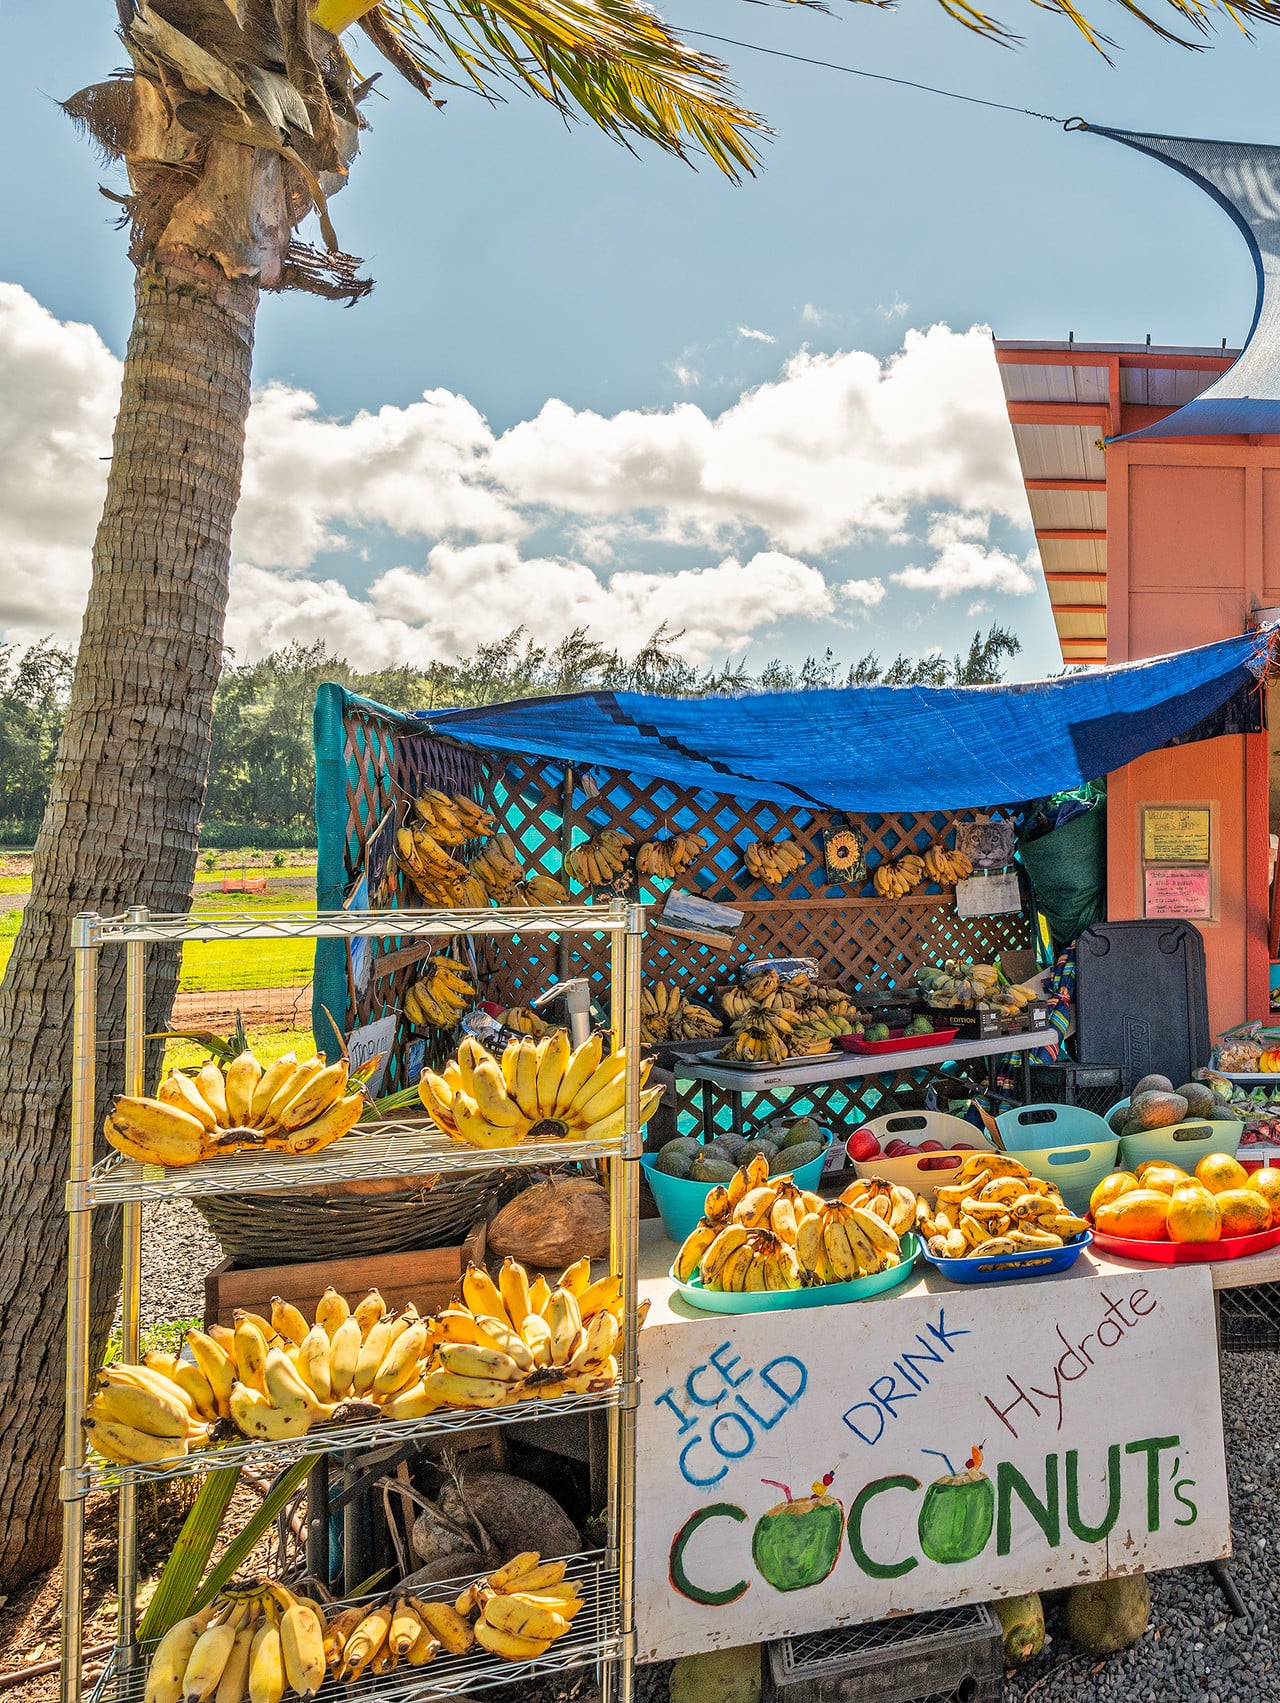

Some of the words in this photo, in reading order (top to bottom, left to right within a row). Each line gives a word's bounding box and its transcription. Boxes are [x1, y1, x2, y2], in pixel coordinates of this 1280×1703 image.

[655, 1340, 753, 1435] ICE
[678, 1355, 809, 1488] COLD
[842, 1308, 971, 1445] DRINK
[983, 1284, 1158, 1439] Hydrate
